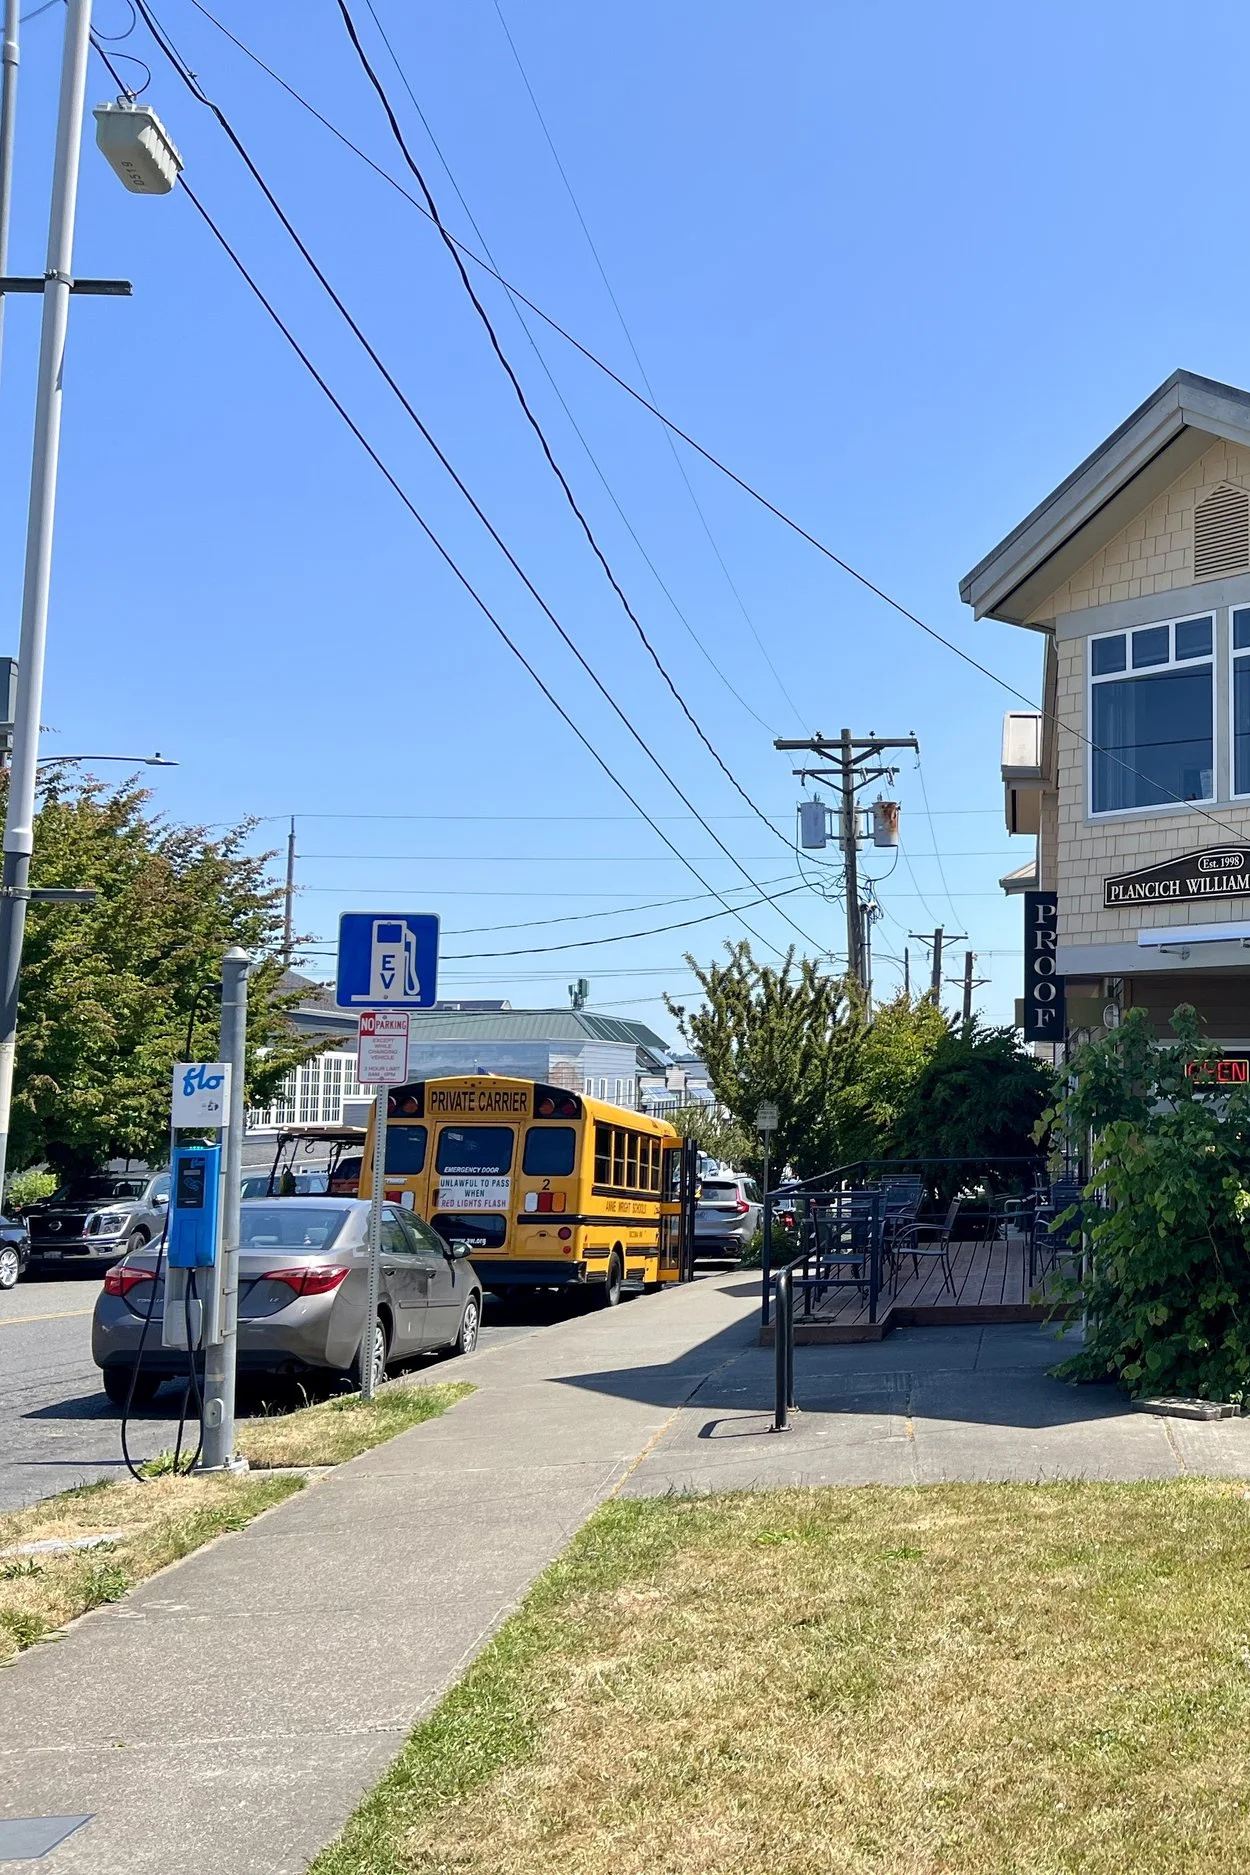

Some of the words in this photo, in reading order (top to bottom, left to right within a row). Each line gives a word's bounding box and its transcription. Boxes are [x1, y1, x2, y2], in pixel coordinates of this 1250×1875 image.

[1203, 859, 1218, 869] Est.
[1221, 857, 1240, 868] 1998
[1111, 881, 1180, 901] PLANCICH
[380, 955, 396, 990] EV
[1034, 904, 1056, 1028] PROOF
[361, 1017, 375, 1031] NO
[376, 1020, 407, 1030] PARKING
[183, 1064, 224, 1096] flo
[431, 1091, 475, 1111] PRIVATE
[479, 1091, 527, 1112] CARRIER
[440, 1179, 478, 1187] UNLAWFUL
[542, 1179, 550, 1190] 2
[464, 1189, 485, 1197] WHEN
[441, 1199, 455, 1207] RED
[457, 1200, 482, 1208] LIGHTS
[484, 1200, 506, 1208] FLASH
